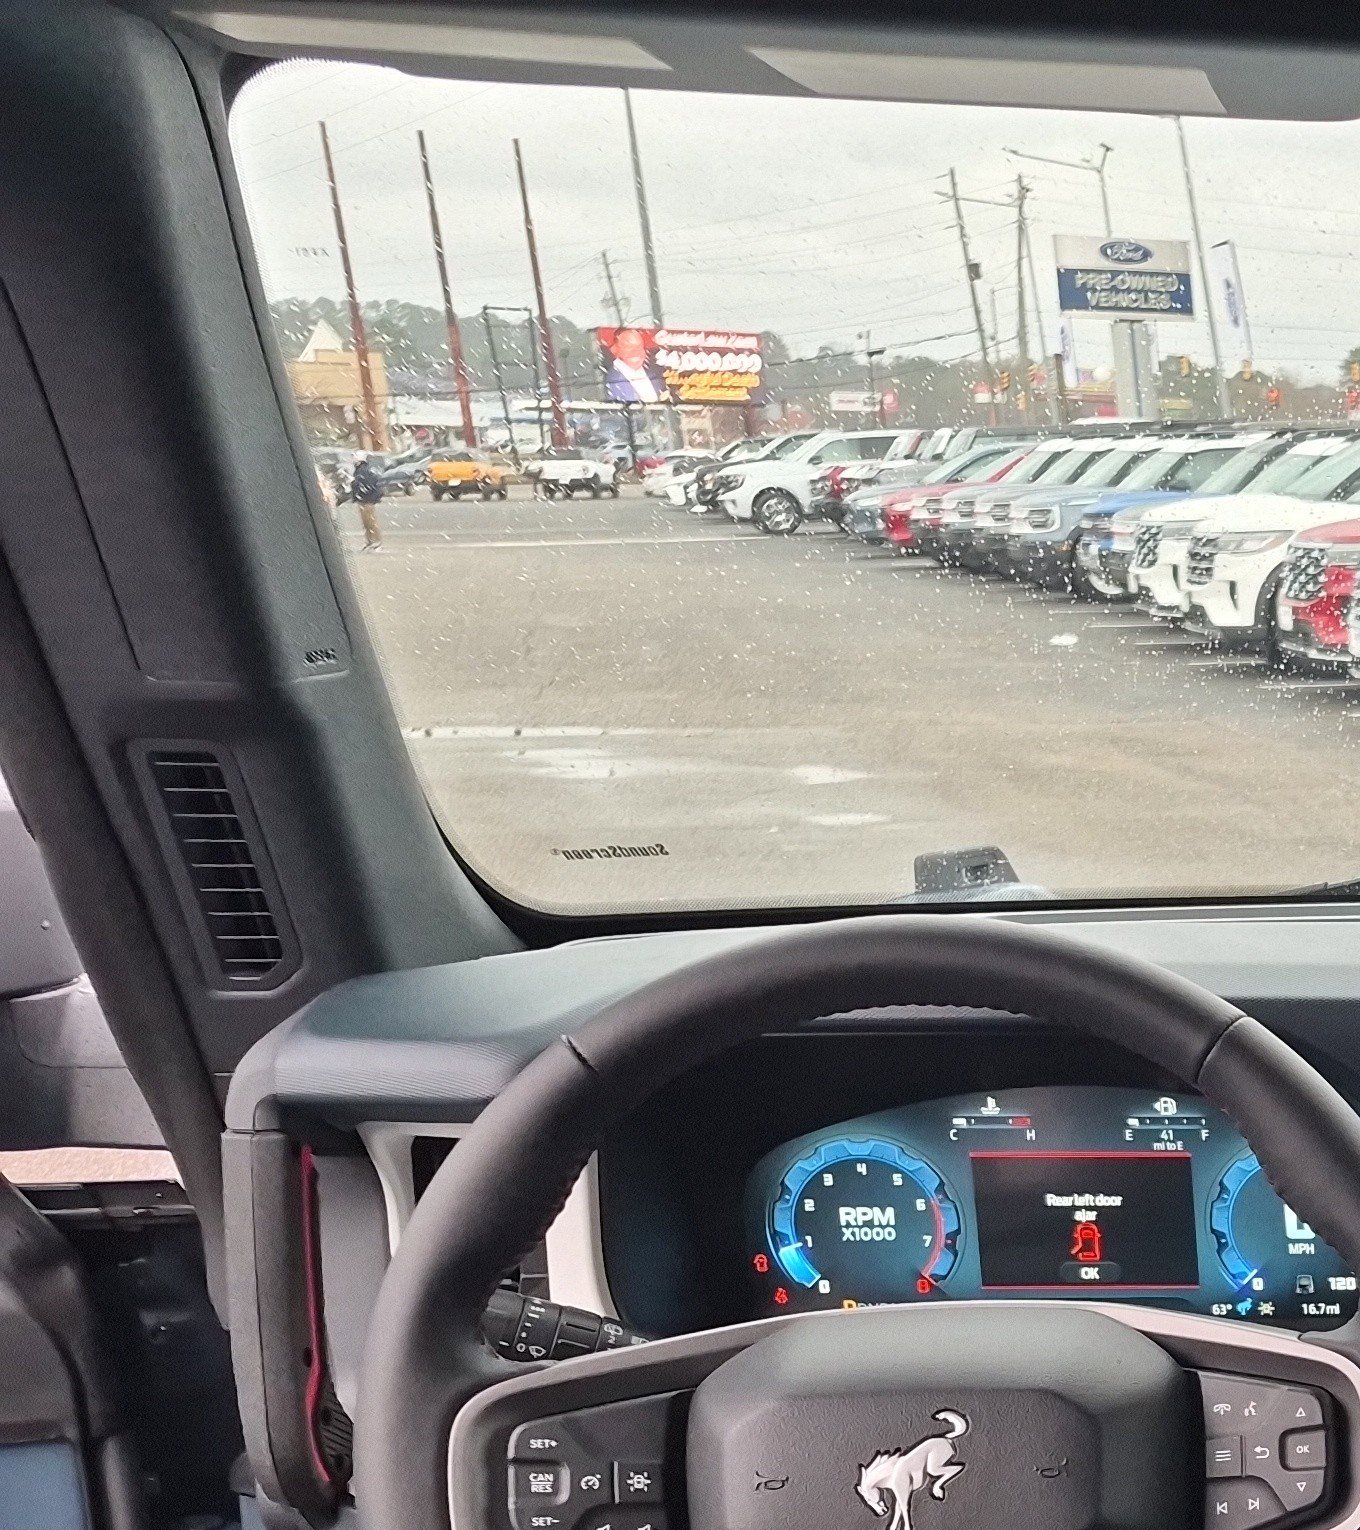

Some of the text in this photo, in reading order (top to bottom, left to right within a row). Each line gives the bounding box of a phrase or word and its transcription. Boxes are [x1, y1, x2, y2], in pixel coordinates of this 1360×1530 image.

[1104, 243, 1148, 262] Ford
[1075, 272, 1179, 292] PRE-OWNED
[949, 1129, 958, 1141] C
[1026, 1129, 1036, 1141] H
[1125, 1130, 1133, 1141] E
[1160, 1129, 1174, 1141] 41
[1201, 1130, 1210, 1141] F
[856, 1163, 867, 1176] 4
[823, 1173, 834, 1186] 3
[892, 1173, 903, 1186] 5
[804, 1199, 815, 1211] 2
[916, 1198, 926, 1211] 6
[1045, 1194, 1072, 1206] Rear
[1096, 1193, 1123, 1206] door
[839, 1207, 895, 1226] RPM
[1073, 1209, 1097, 1223] ajar
[842, 1227, 896, 1241] X1000
[805, 1235, 813, 1247] 1
[922, 1235, 933, 1248] 7
[1288, 1243, 1315, 1255] MPH
[1080, 1267, 1100, 1280] OK
[819, 1280, 830, 1293] 0
[1252, 1277, 1264, 1291] 0
[1327, 1276, 1356, 1290] 120
[1295, 1444, 1311, 1455] OK
[528, 1472, 554, 1482] CAN
[530, 1484, 554, 1493] RES
